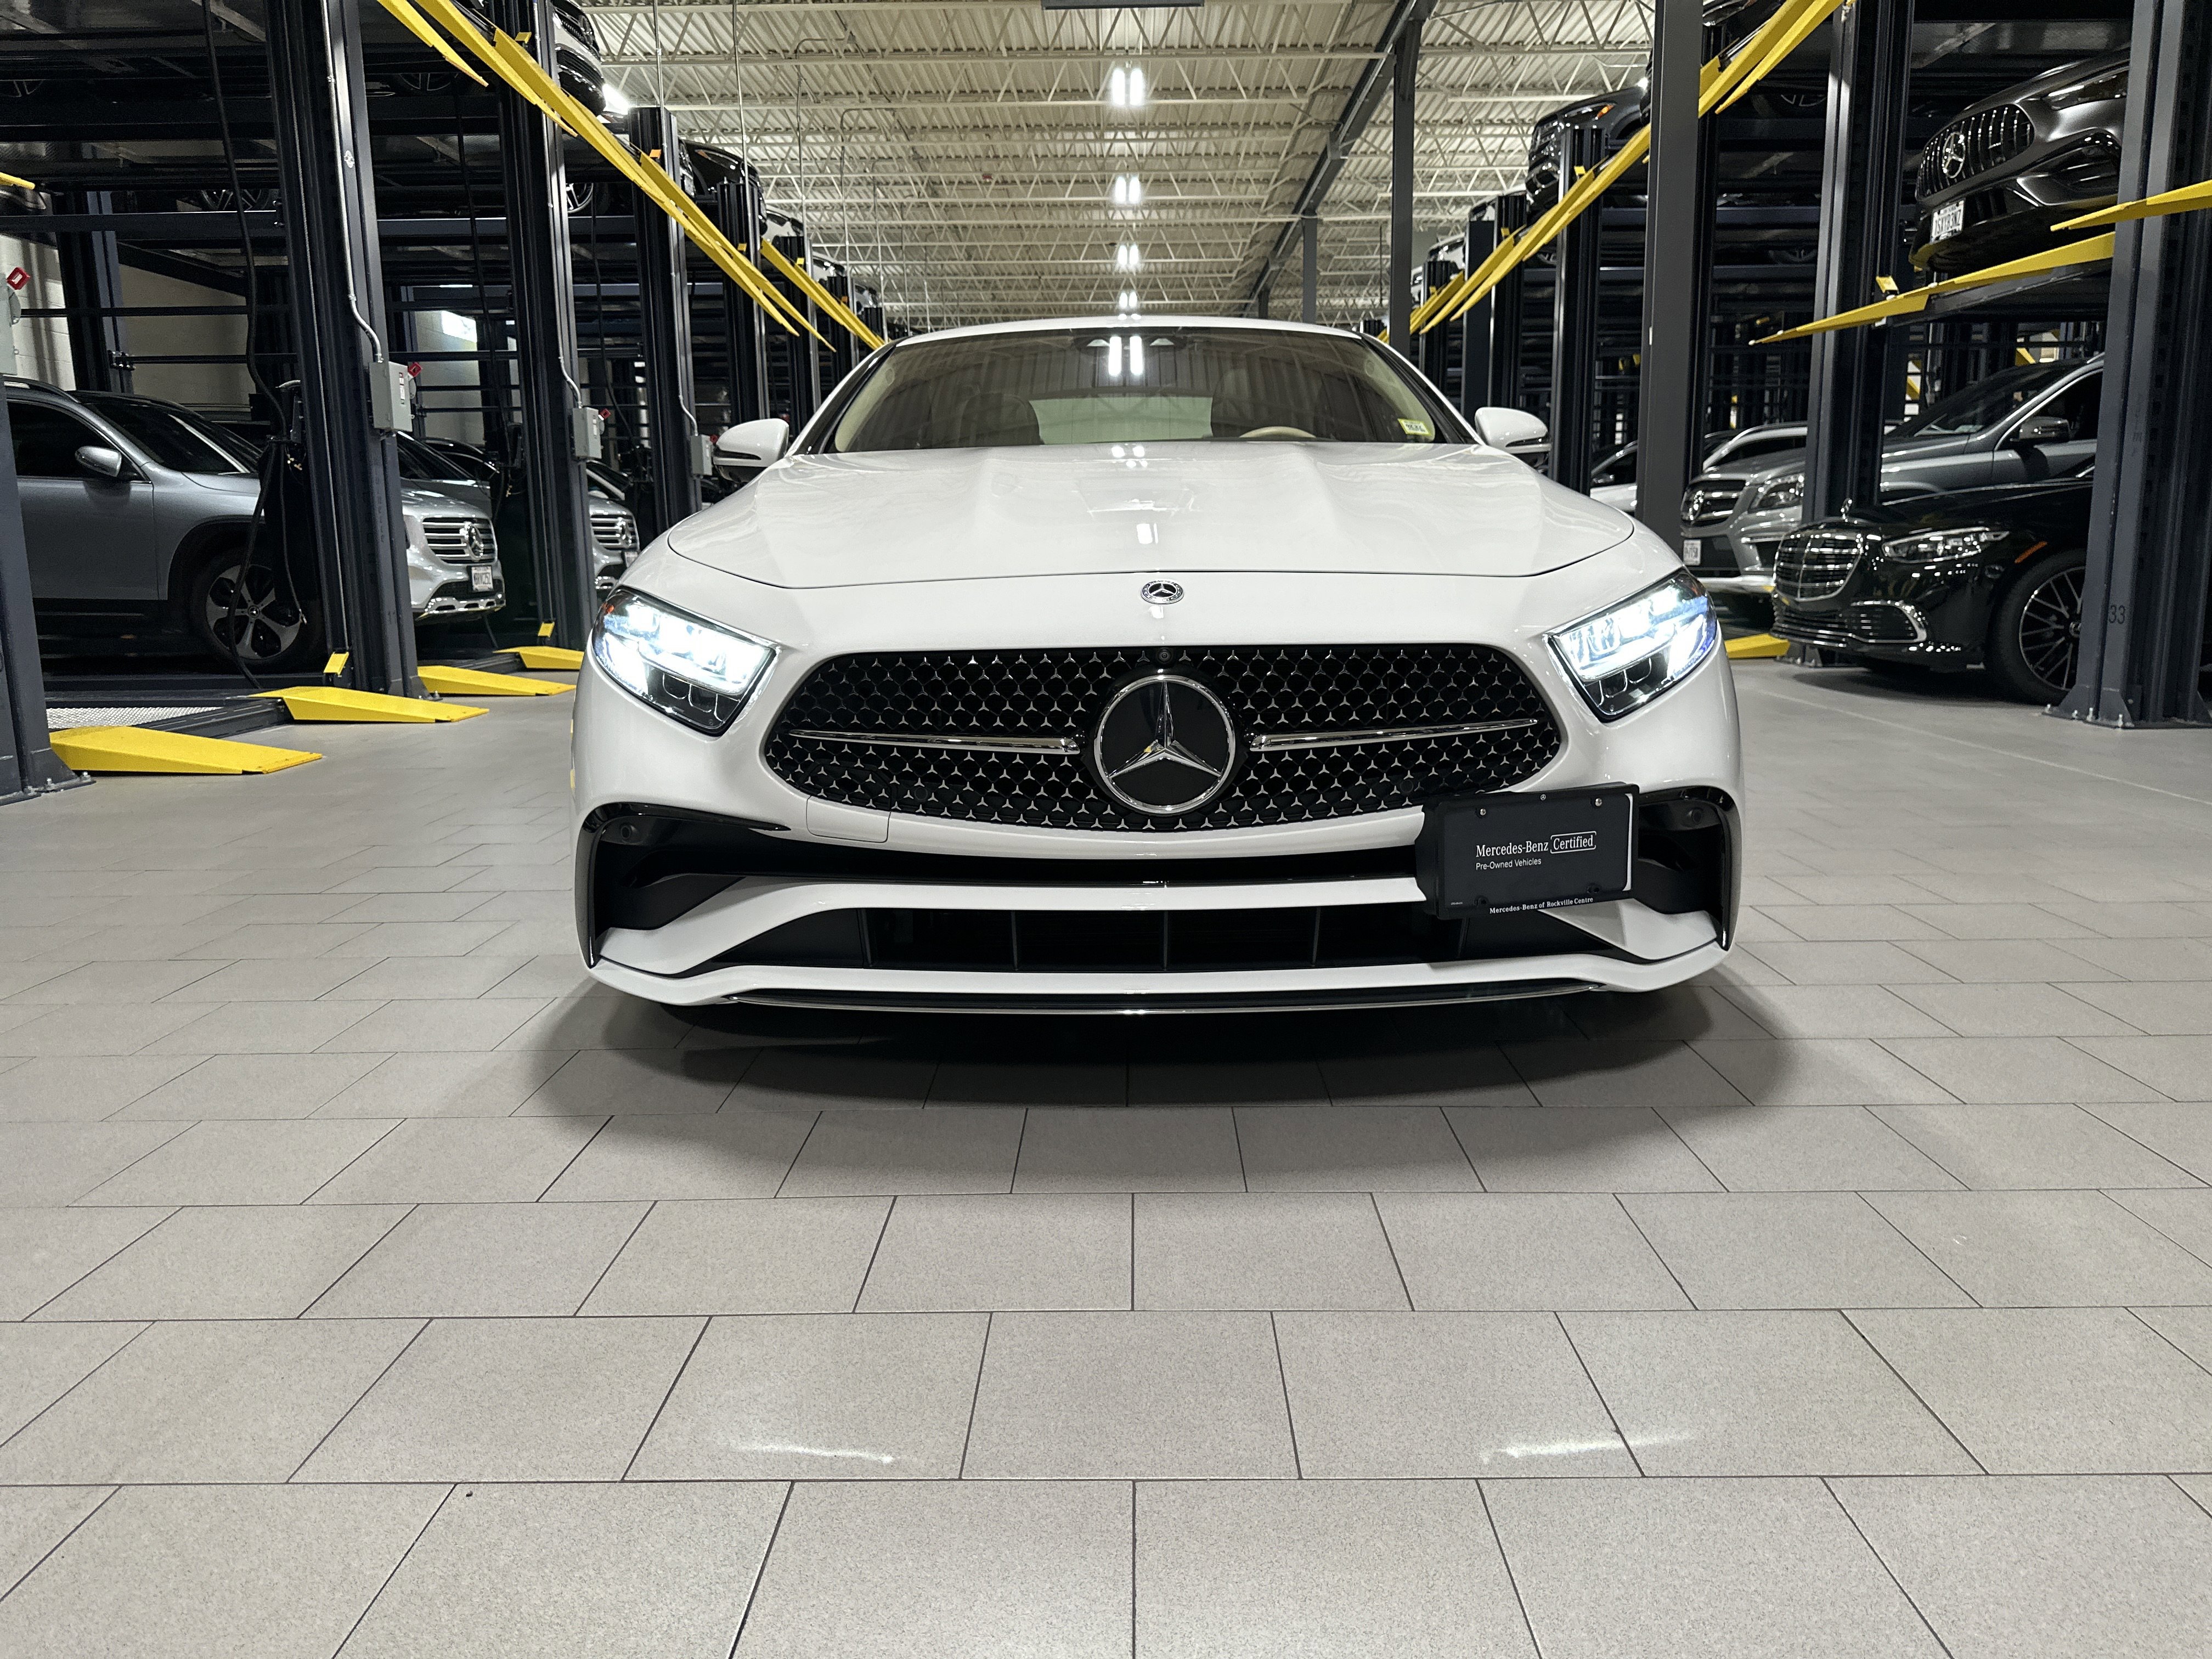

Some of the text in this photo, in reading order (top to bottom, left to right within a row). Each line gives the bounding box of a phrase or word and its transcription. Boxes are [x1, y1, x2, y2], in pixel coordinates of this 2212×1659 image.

[2108, 605, 2126, 624] 33
[1476, 834, 1593, 857] Mercedes-Benz Certified
[1476, 857, 1542, 871] Pre-Owned Vehicles
[1489, 904, 1538, 914] Mercedes-Benz
[1547, 899, 1573, 907] Rockville
